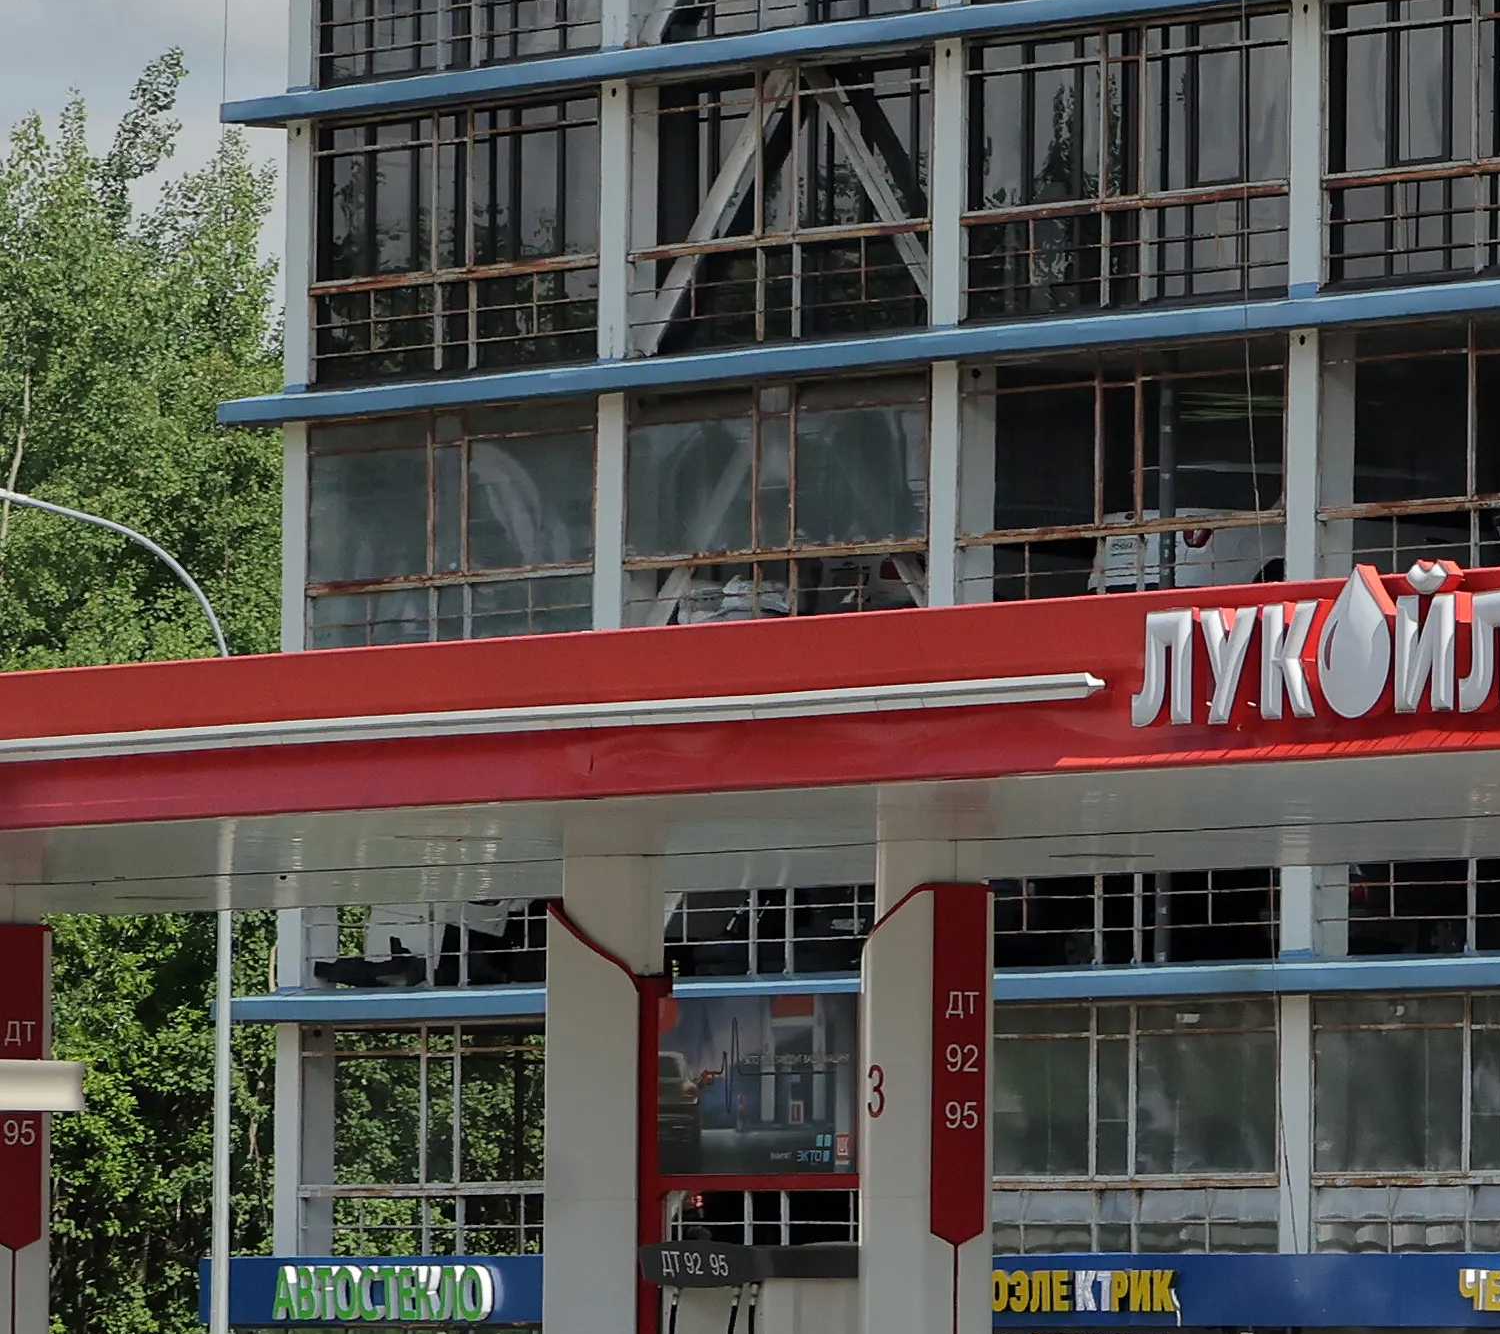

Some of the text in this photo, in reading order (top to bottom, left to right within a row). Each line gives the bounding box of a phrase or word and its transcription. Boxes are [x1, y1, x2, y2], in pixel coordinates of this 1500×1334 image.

[945, 991, 980, 1020] ДТ
[4, 1020, 36, 1046] ДТ
[945, 1043, 979, 1073] 92
[867, 1064, 885, 1118] 3
[945, 1101, 979, 1129] 95
[3, 1119, 36, 1146] 95
[661, 1250, 729, 1277] ДТ 92 95
[271, 1264, 495, 1322] АВТОСТЕКЛО
